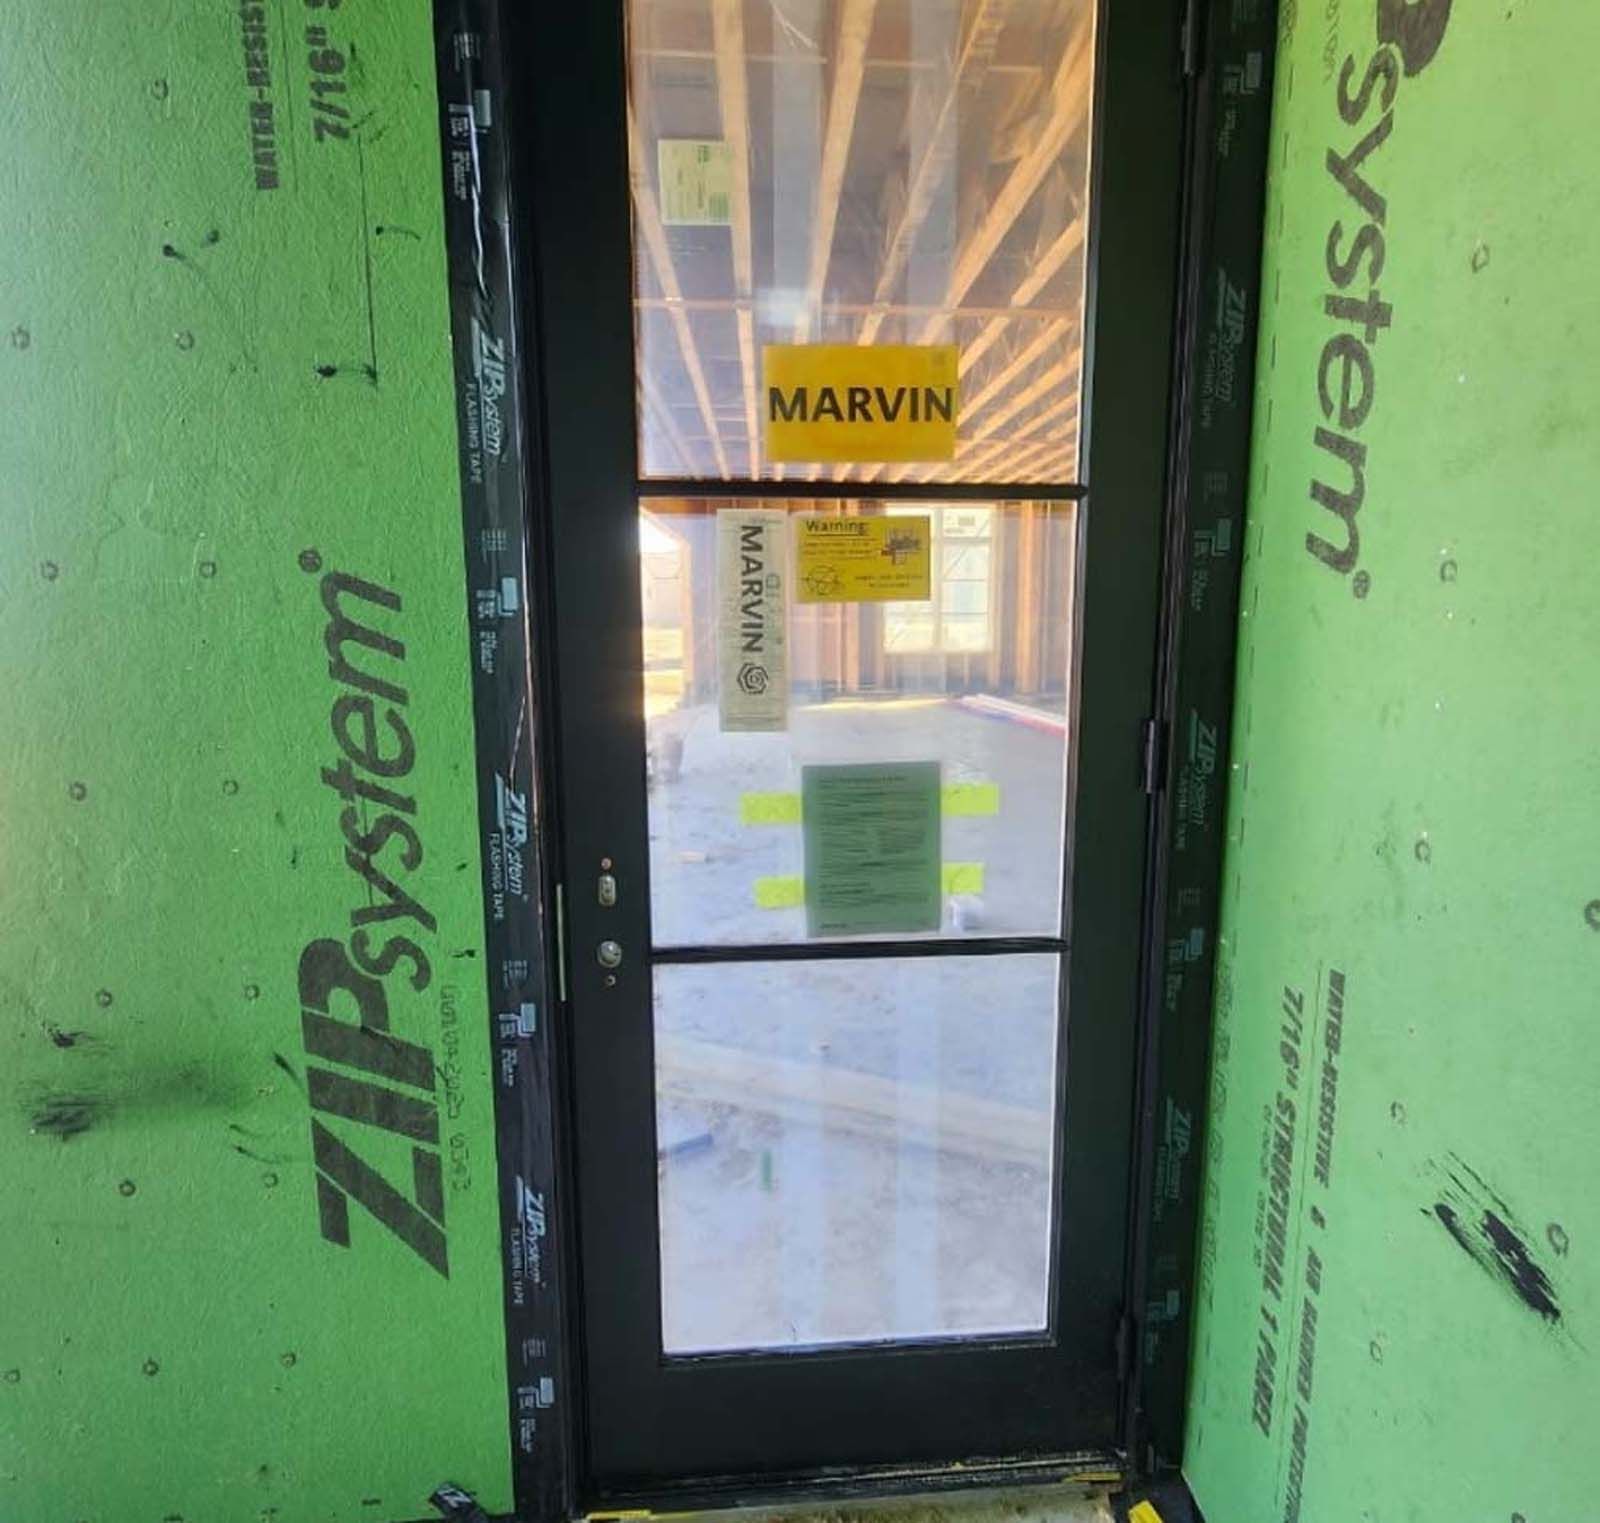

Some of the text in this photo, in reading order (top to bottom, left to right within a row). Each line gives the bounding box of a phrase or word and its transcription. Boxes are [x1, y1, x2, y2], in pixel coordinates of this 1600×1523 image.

[241, 0, 279, 190] WATER-RESIS
[769, 386, 953, 422] MARVIN
[740, 525, 764, 652] MARVIN
